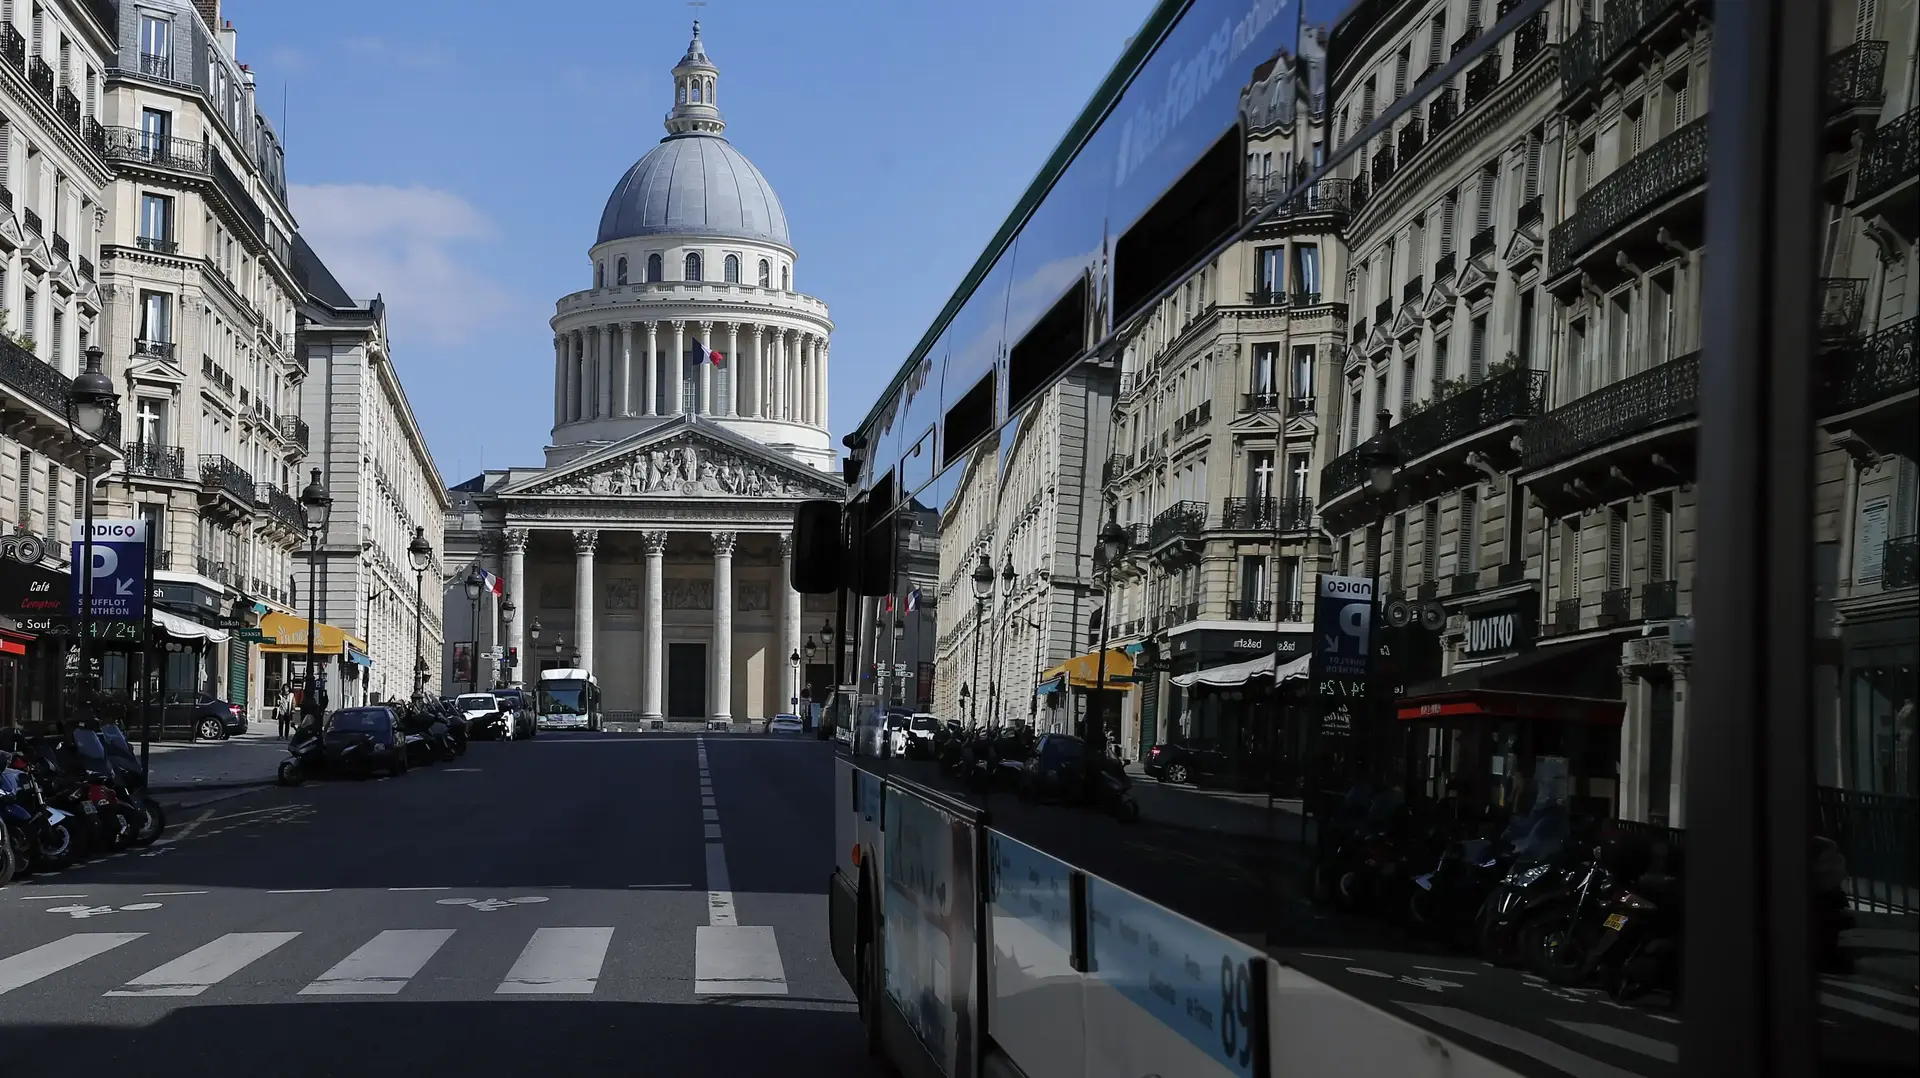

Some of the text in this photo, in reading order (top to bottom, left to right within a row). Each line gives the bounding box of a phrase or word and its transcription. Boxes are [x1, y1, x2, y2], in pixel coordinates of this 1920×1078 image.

[81, 525, 135, 537] INDIGO
[79, 545, 118, 595] P
[30, 581, 51, 592] Café
[78, 606, 129, 615] PNTHÉON
[116, 621, 136, 638] 24
[1221, 954, 1252, 1068] 89
